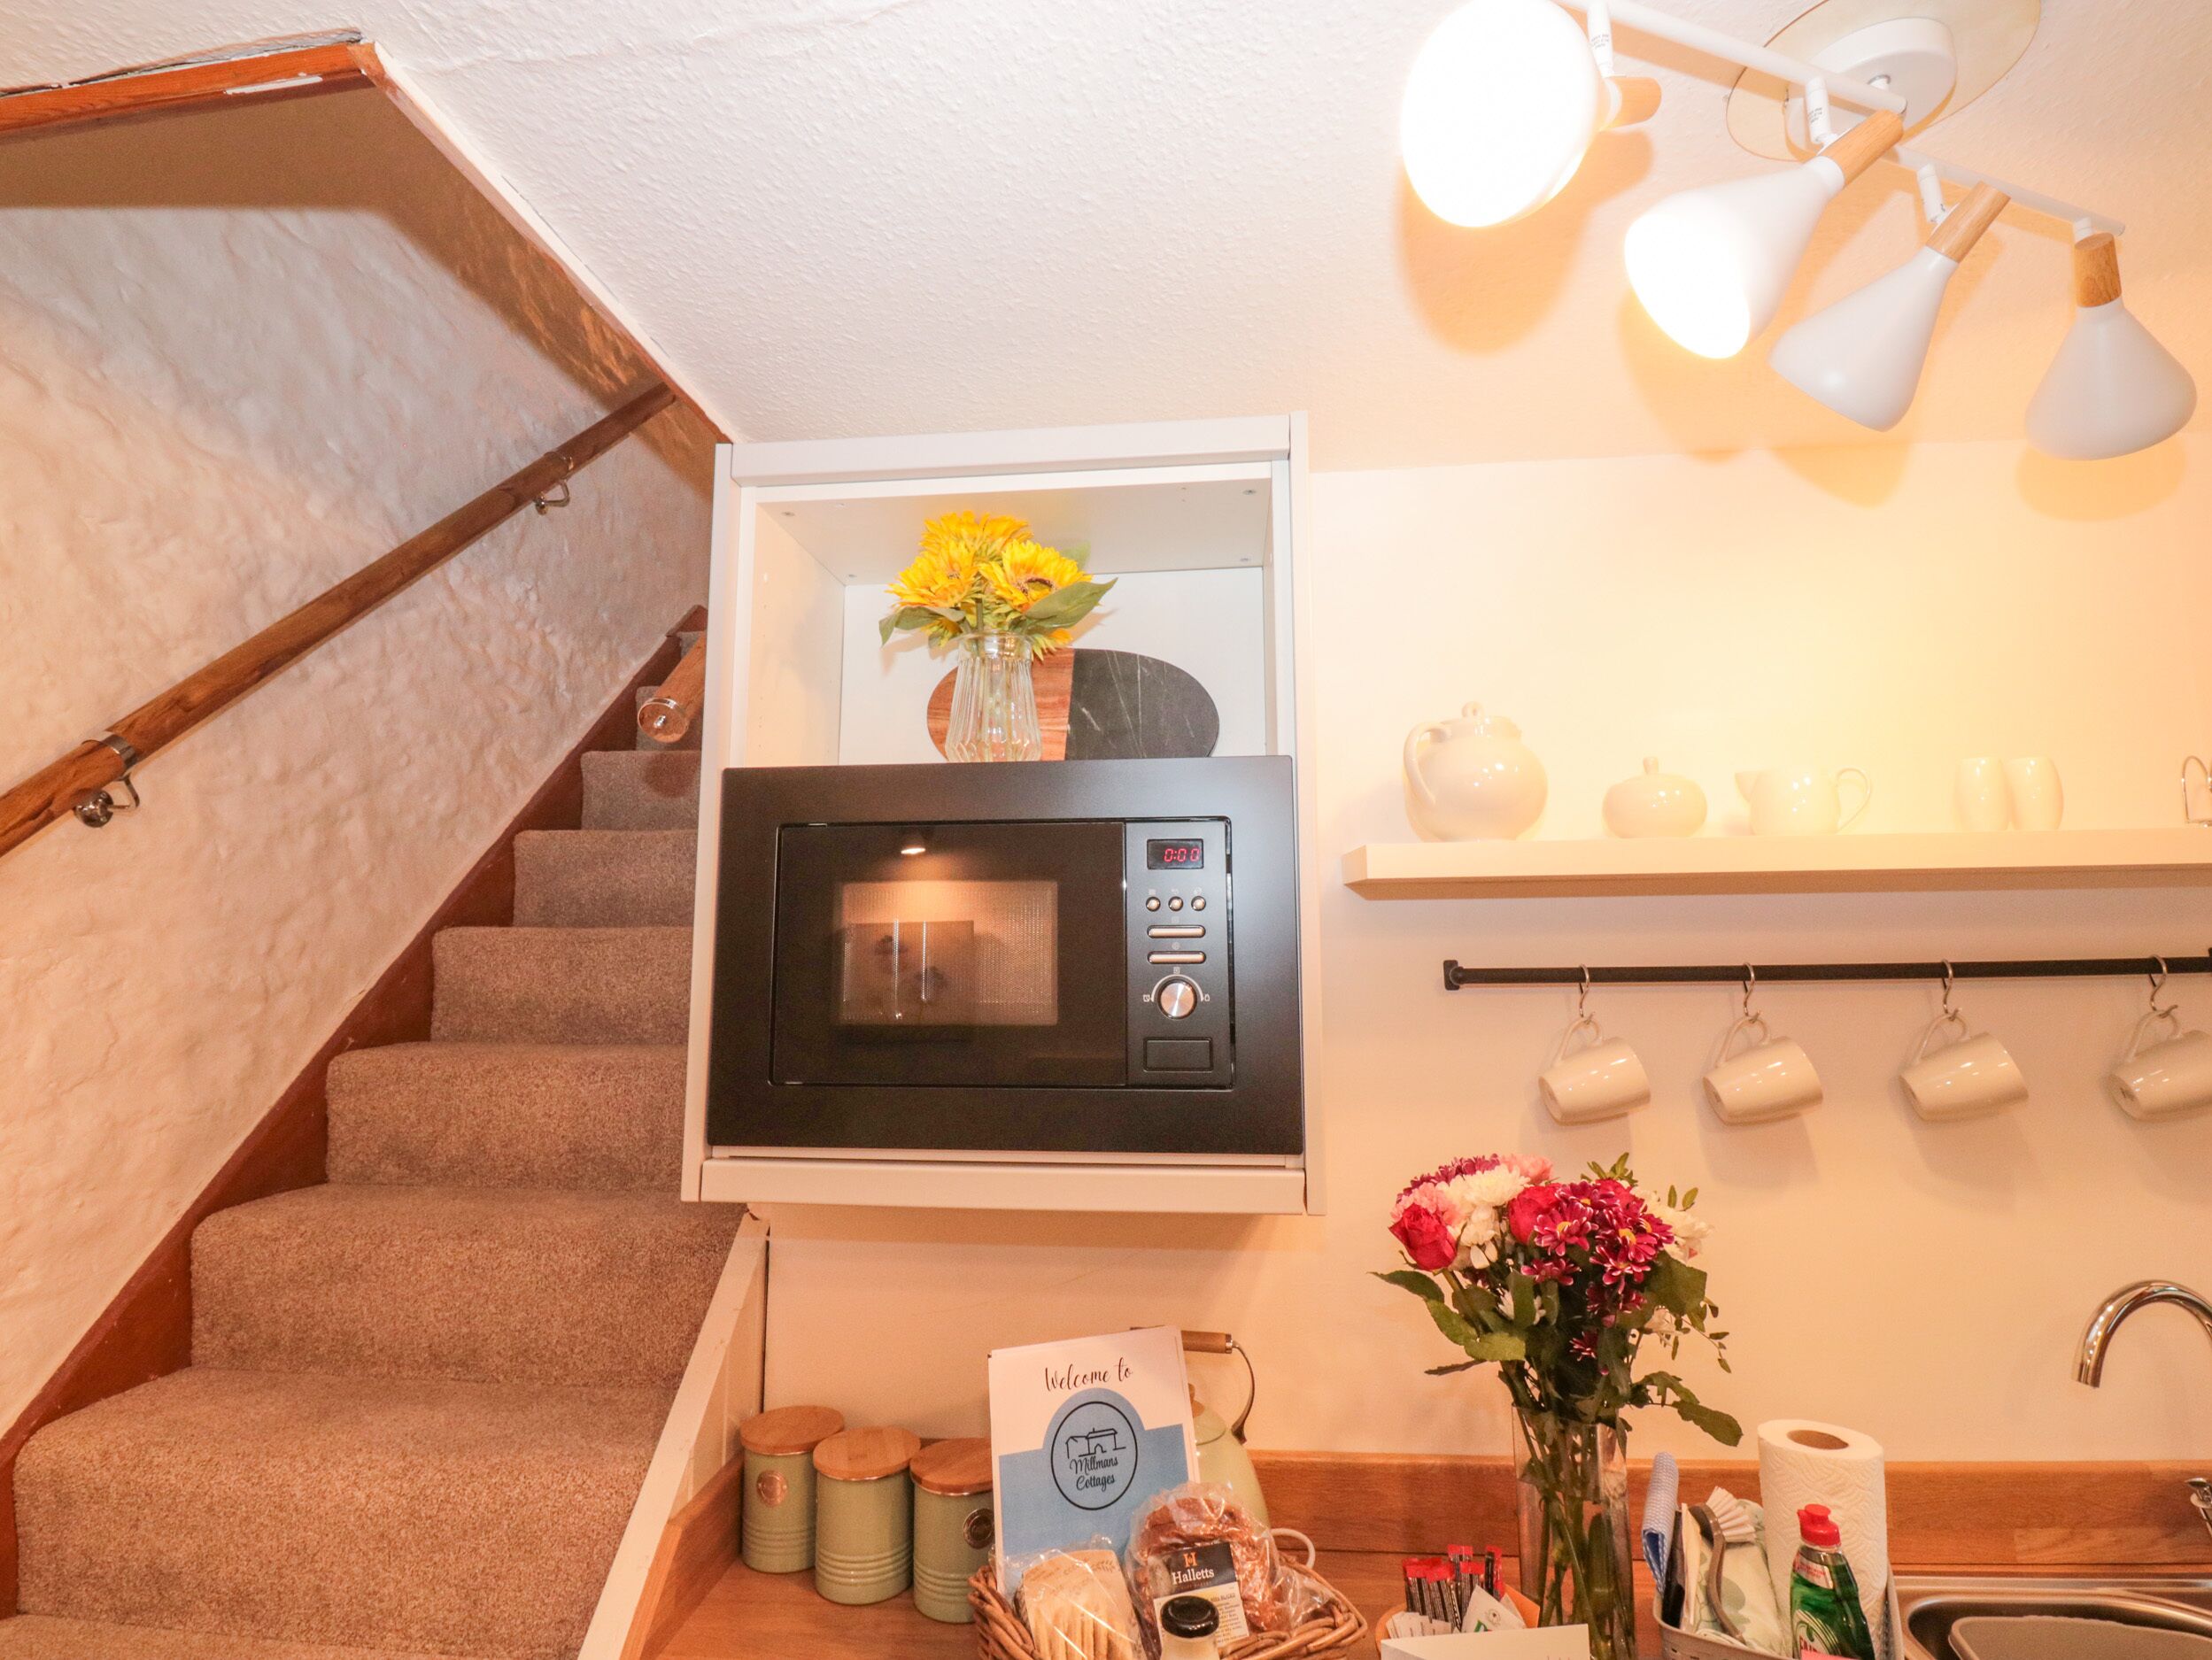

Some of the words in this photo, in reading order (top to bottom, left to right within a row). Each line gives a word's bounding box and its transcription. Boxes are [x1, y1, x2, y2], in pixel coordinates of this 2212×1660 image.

[1164, 847, 1200, 862] 0:00
[1045, 1363, 1111, 1392] Welcome
[1114, 1356, 1133, 1382] to
[1070, 1455, 1118, 1475] Millmans
[1076, 1473, 1116, 1492] Cottages
[1172, 1568, 1215, 1586] Halletts
